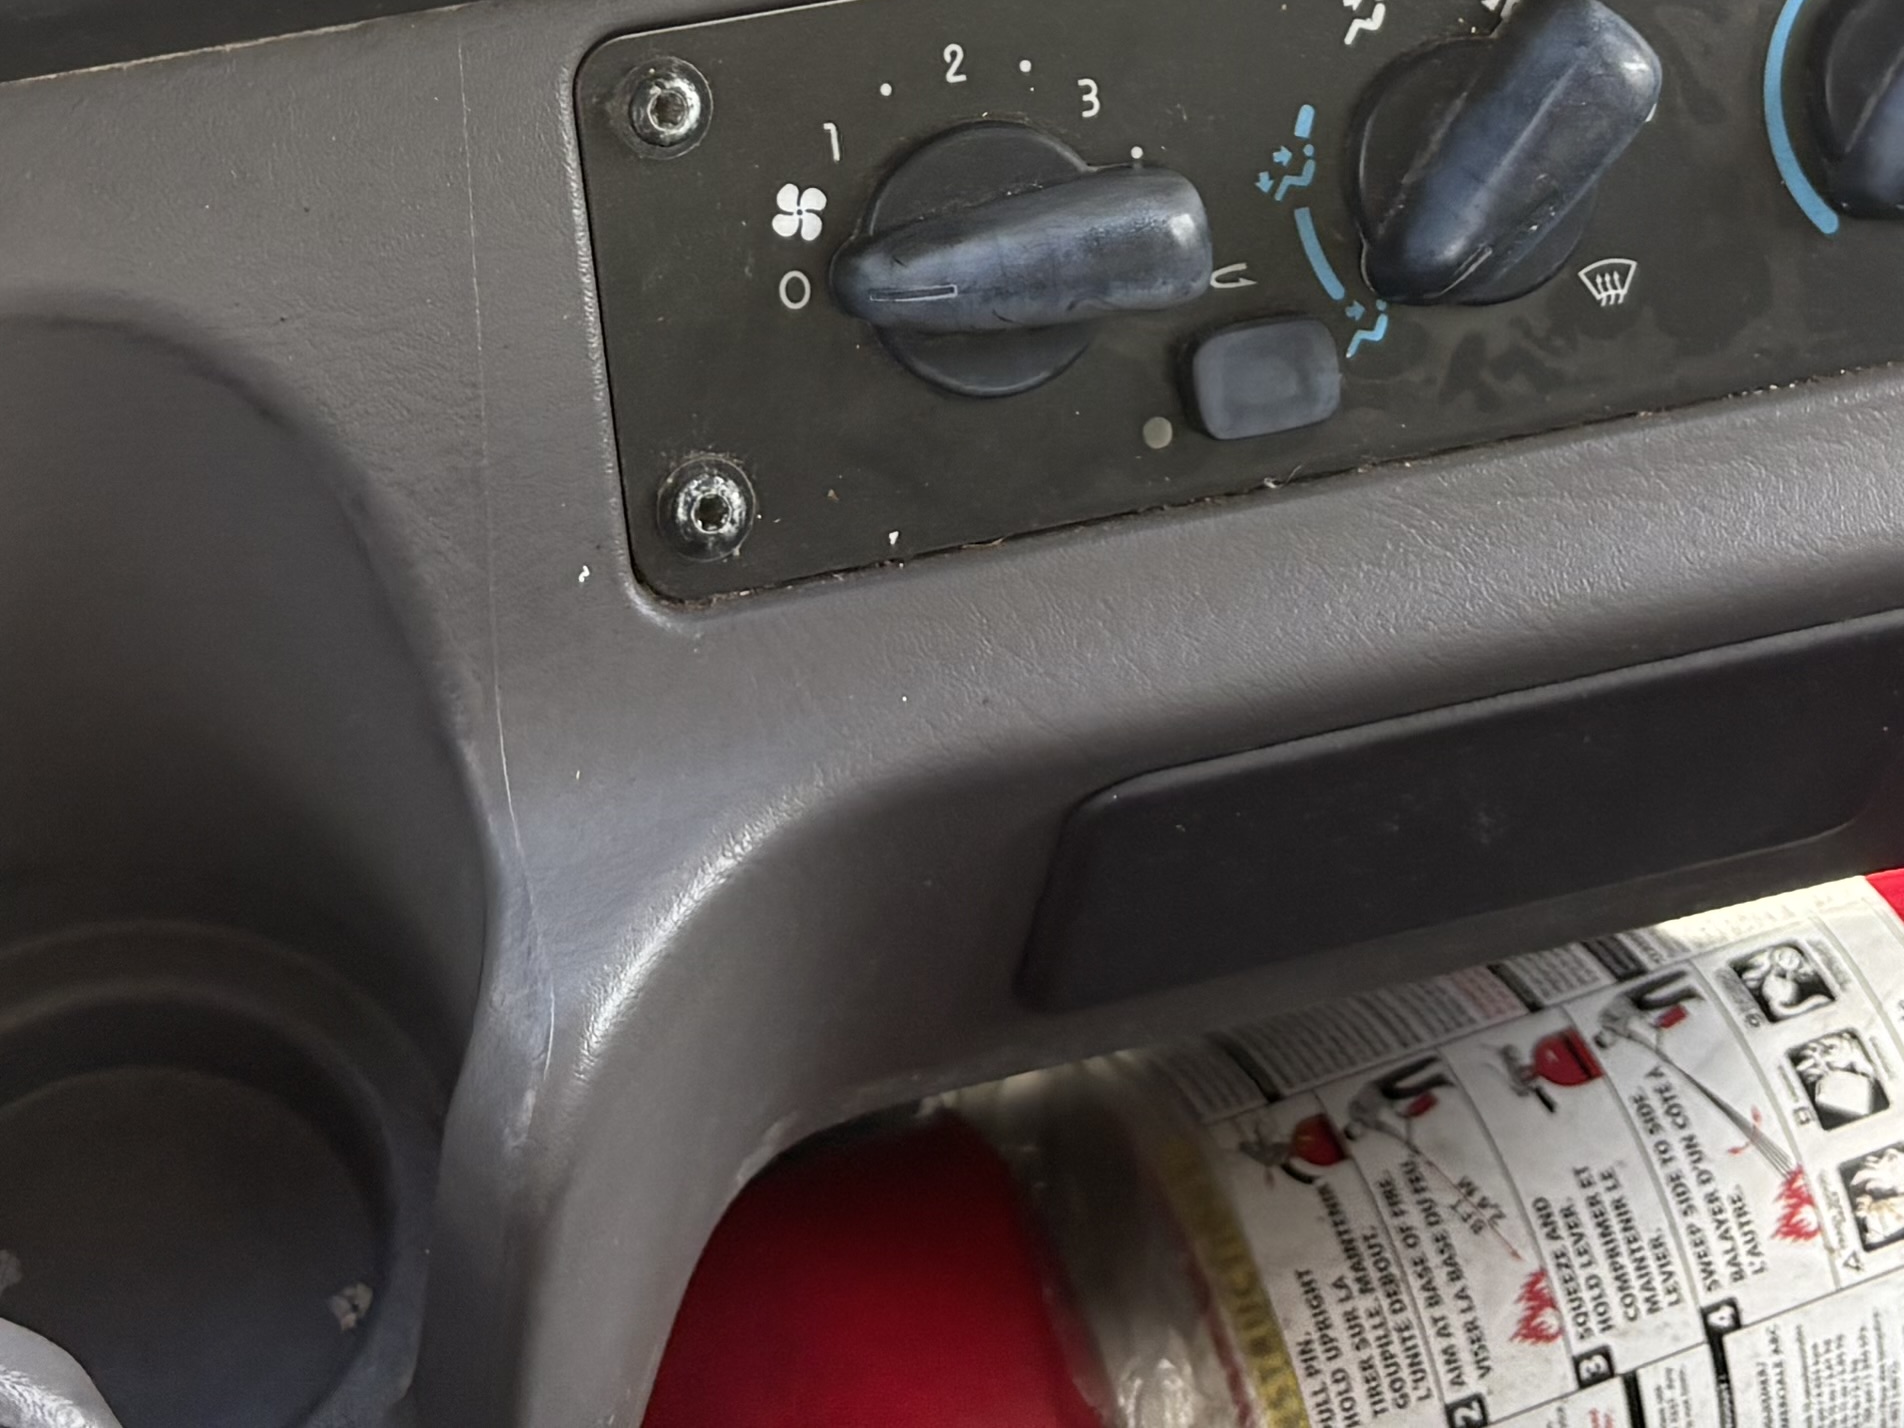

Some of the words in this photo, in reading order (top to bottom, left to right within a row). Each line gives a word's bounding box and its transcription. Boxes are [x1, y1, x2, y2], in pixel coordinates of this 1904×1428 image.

[943, 42, 968, 84] 2
[1078, 77, 1101, 118] 3
[822, 122, 843, 162] 1
[1570, 1161, 1596, 1191] ET
[1650, 1137, 1675, 1167] TO
[1679, 1131, 1714, 1187] D'UN
[1596, 1165, 1621, 1194] LE
[1666, 1169, 1696, 1218] SIDE
[1396, 1219, 1422, 1251] OF
[1414, 1195, 1442, 1229] DU
[1531, 1193, 1562, 1243] AND
[1554, 1194, 1596, 1271] LEVER.
[1699, 1188, 1748, 1284] BALAYER
[1431, 1230, 1464, 1284] BASE
[1581, 1190, 1643, 1325] COMPRIMER
[1607, 1193, 1664, 1316] MAINTENIR
[1643, 1226, 1685, 1308] LEVIER.
[1681, 1219, 1721, 1294] SWEEP
[1328, 1273, 1354, 1305] LA
[1409, 1254, 1443, 1310] BASE
[1451, 1284, 1476, 1315] LA
[1549, 1246, 1595, 1341] SQUEEZE
[1581, 1271, 1616, 1333] HOLD
[1293, 1264, 1342, 1363] UPRIGHT
[1340, 1306, 1370, 1353] SUR
[1430, 1313, 1453, 1341] AT
[1707, 1301, 1738, 1332] 4
[1291, 1330, 1323, 1379] PIN.
[1439, 1343, 1469, 1389] AIM
[1460, 1316, 1497, 1380] VISER
[1576, 1352, 1610, 1380] 3
[1354, 1354, 1391, 1418] TIRER
[1451, 1399, 1482, 1427] 2
